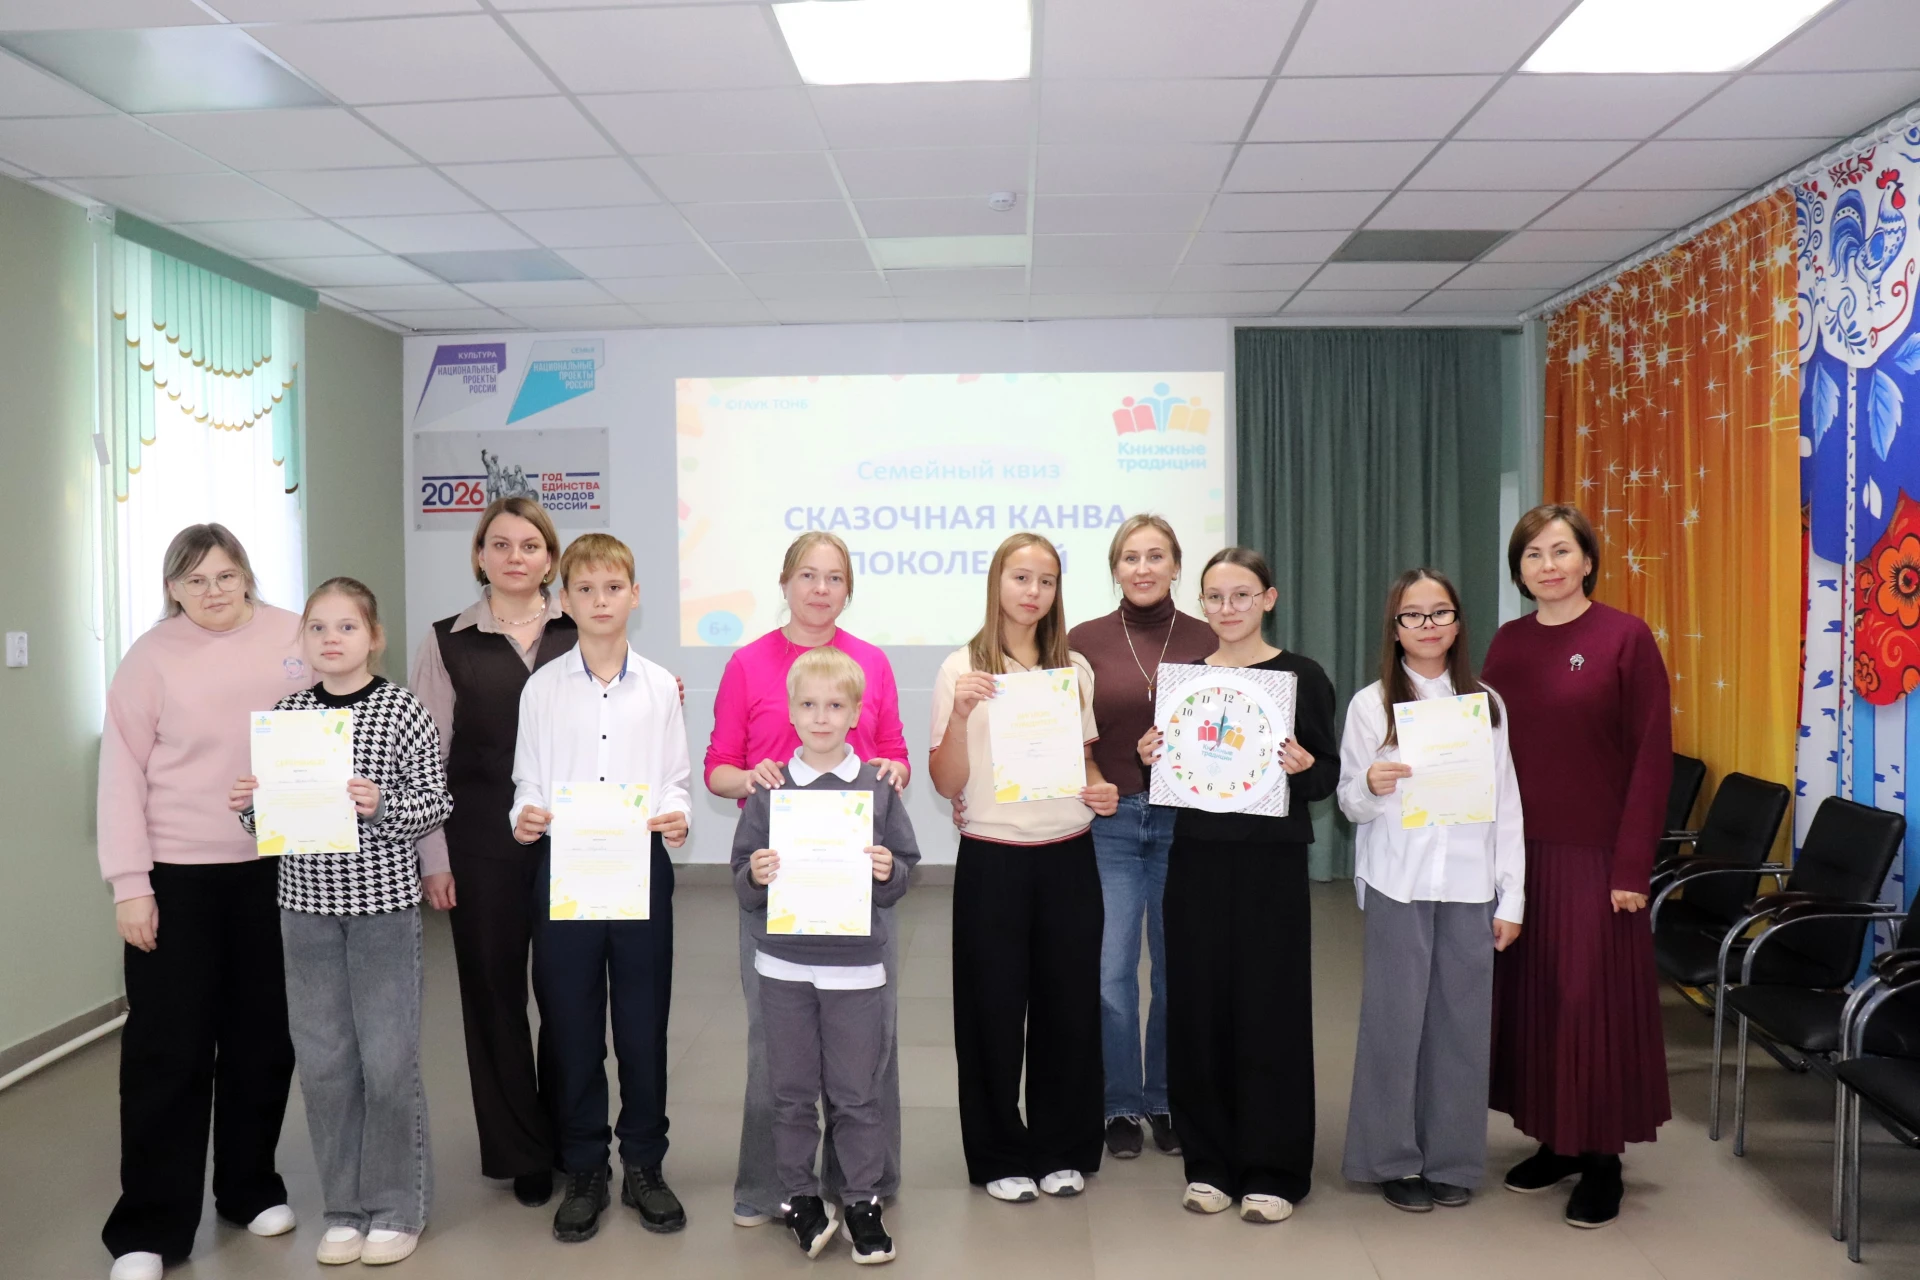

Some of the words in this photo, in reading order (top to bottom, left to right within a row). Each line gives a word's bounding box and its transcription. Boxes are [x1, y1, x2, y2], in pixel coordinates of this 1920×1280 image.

[458, 351, 497, 360] КУЛЬТУРА
[437, 364, 496, 376] НАЦИОНАЛЬНЫЕ
[533, 361, 593, 373] НАЦИОНАЛЬНЫЕ
[462, 374, 496, 384] ПРОЕКТЫ
[559, 371, 593, 381] ПРОЕКТЫ
[469, 384, 497, 393] РОССИИ
[565, 380, 594, 389] РОССИИ
[772, 398, 809, 410] ТОНБ
[1117, 441, 1207, 456] Книжные
[857, 459, 993, 480] Семейный
[1002, 463, 1061, 479] квиз
[1116, 458, 1207, 472] традиции
[542, 473, 563, 482] ГОД
[542, 481, 600, 492] ЕДИНСТВА
[422, 482, 484, 506] 2026
[542, 492, 595, 501] НАРОДОВ
[542, 501, 588, 510] РОССИИ
[784, 505, 995, 531] СКАЗОЧНАЯ
[1008, 504, 1126, 529] КАНВА
[850, 544, 1068, 576] ПОКОЛЕ
[709, 621, 732, 636] 6+
[1202, 695, 1211, 704] 11
[1223, 693, 1234, 704] 12
[1182, 707, 1193, 717] 10
[1174, 729, 1181, 737] 9
[1258, 724, 1265, 734] 2
[1175, 752, 1182, 760] 8
[1259, 748, 1266, 757] 3
[1188, 771, 1194, 780] 7
[1248, 769, 1255, 778] 4
[1206, 782, 1213, 791] 6
[1229, 782, 1236, 790] 5
